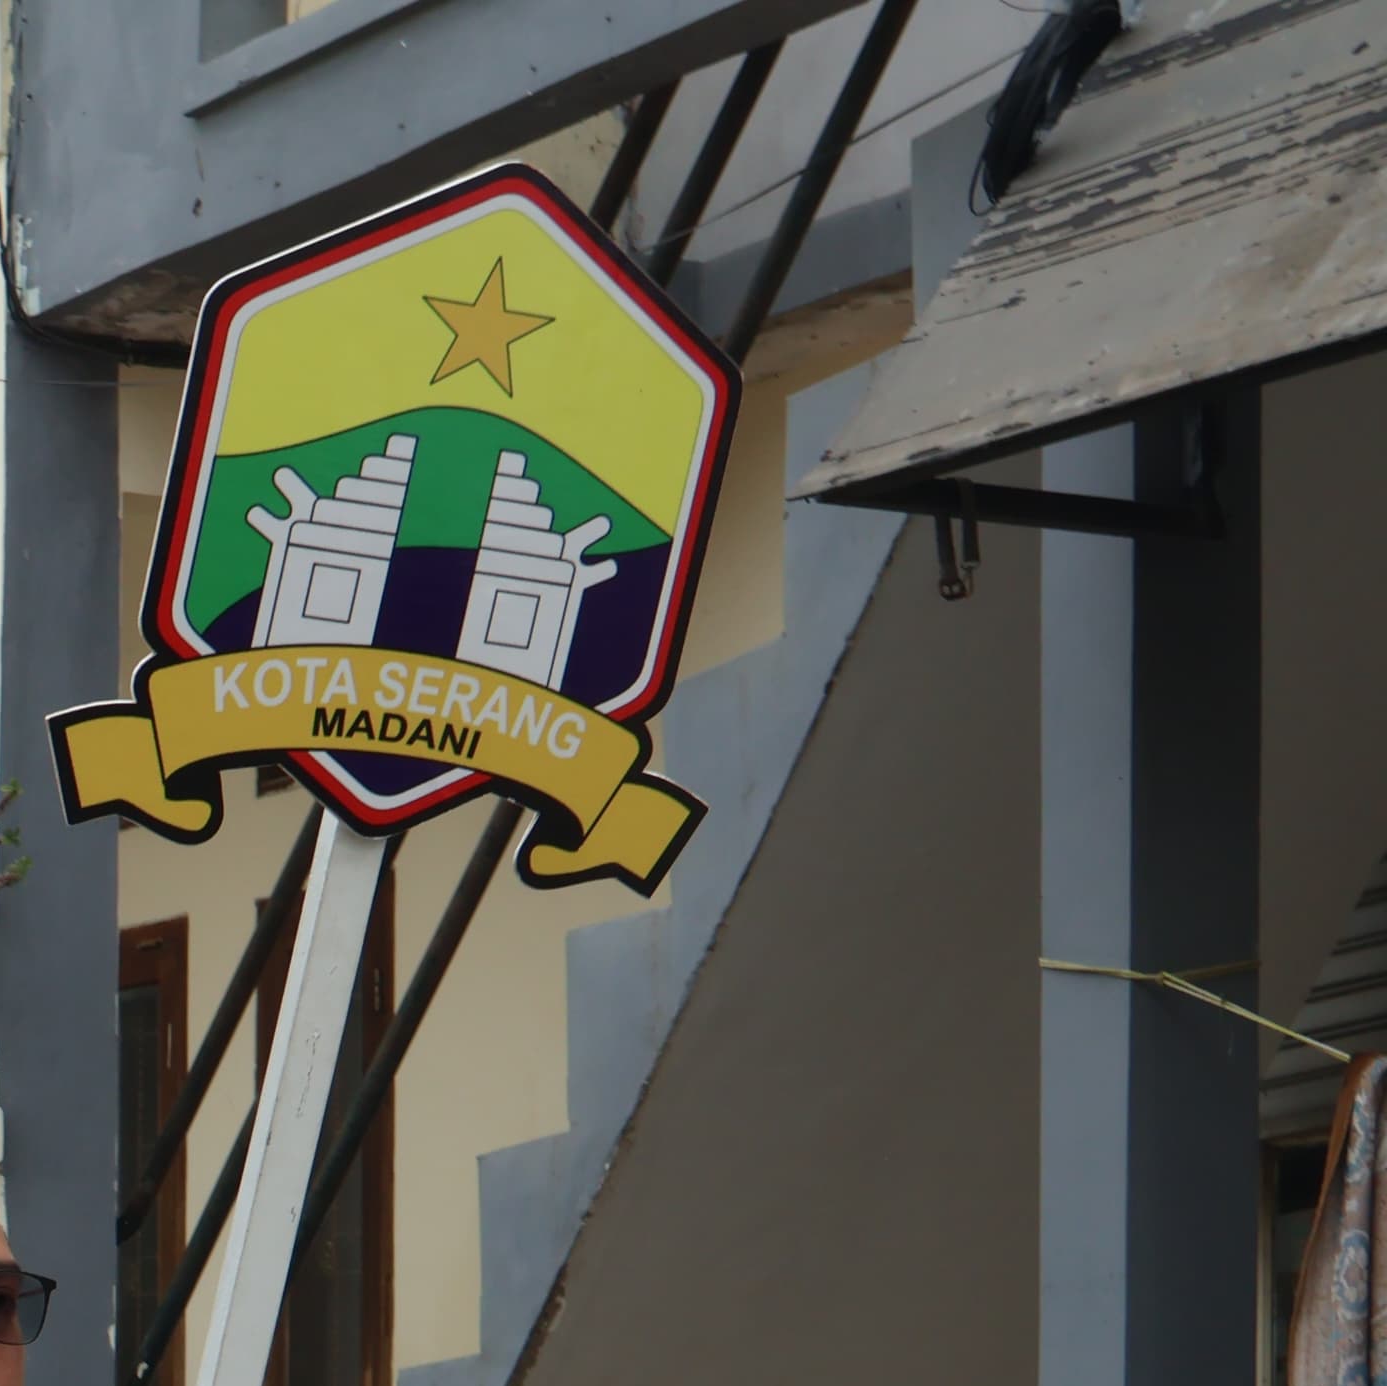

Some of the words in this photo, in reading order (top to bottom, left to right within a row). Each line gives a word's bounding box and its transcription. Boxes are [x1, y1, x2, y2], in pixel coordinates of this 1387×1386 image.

[213, 656, 358, 713] KOTA
[374, 660, 587, 760] SERANG
[312, 707, 482, 759] MADANI
